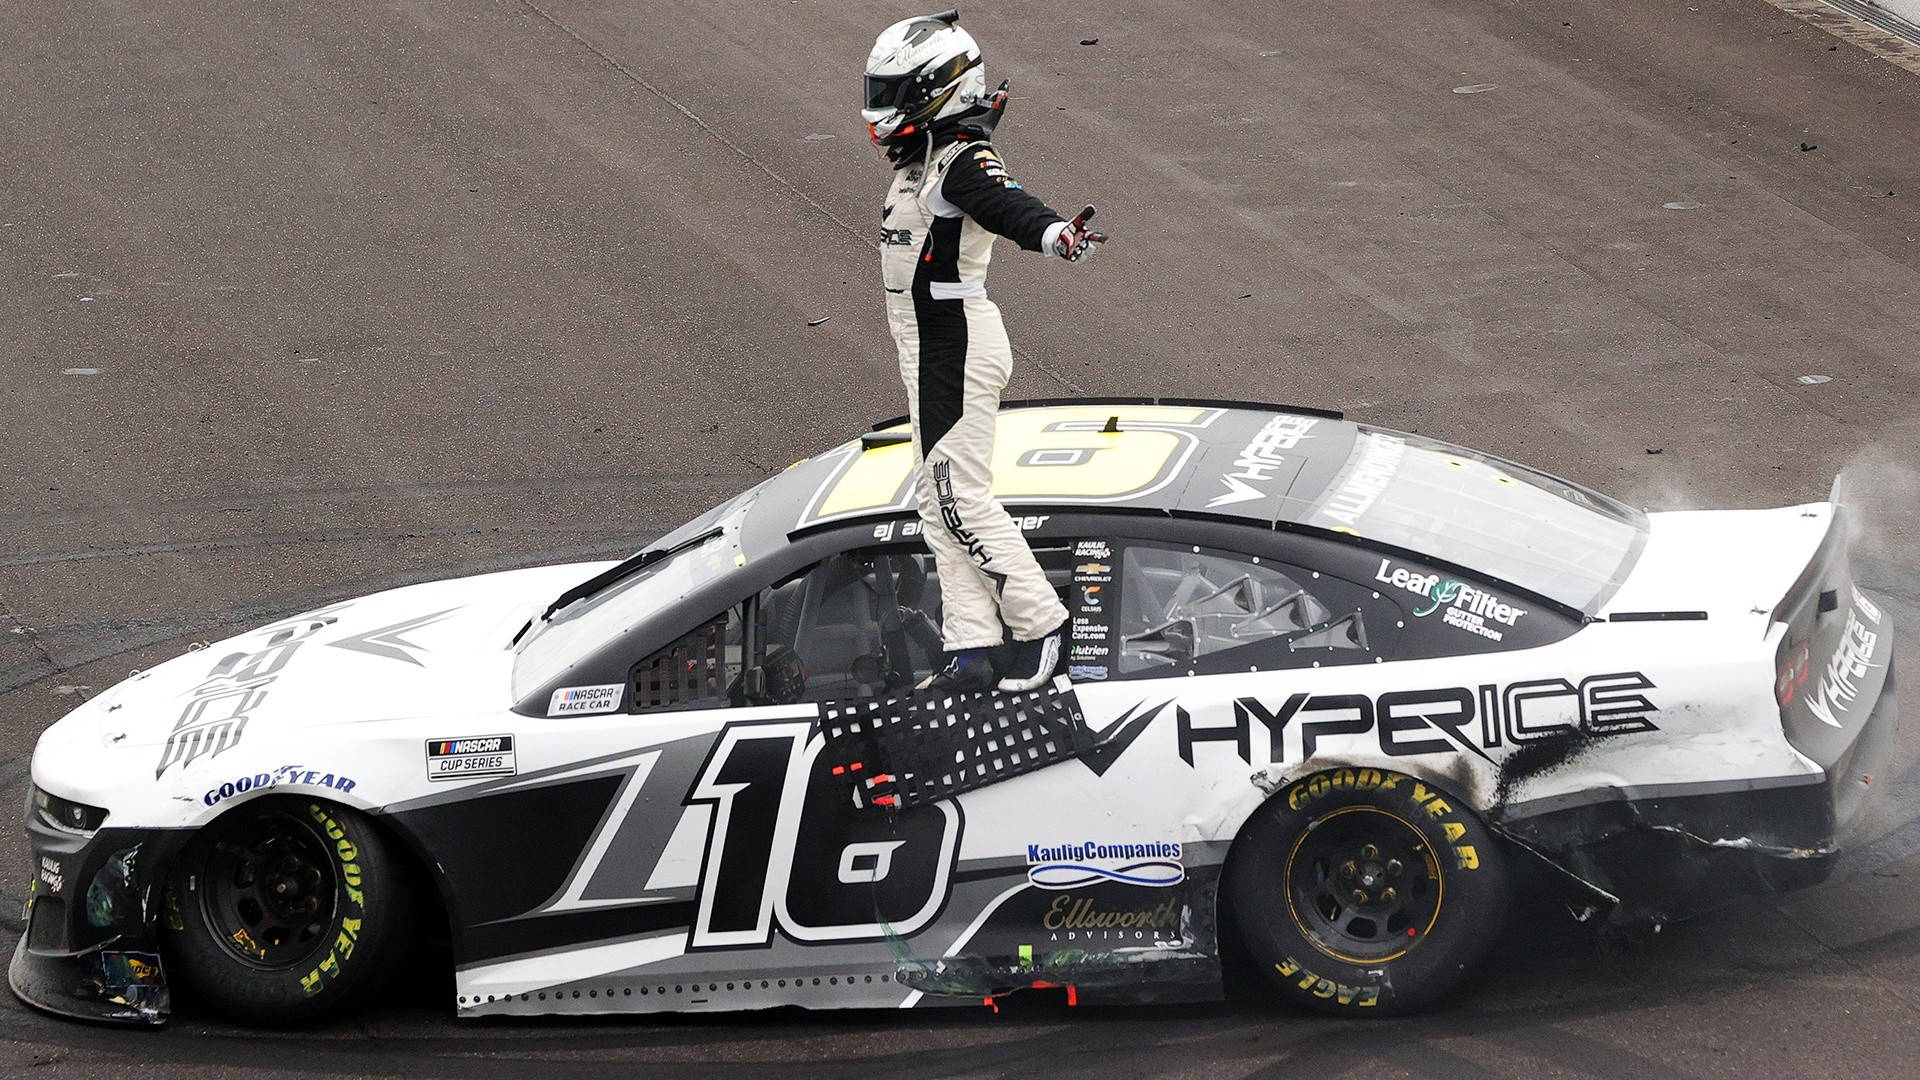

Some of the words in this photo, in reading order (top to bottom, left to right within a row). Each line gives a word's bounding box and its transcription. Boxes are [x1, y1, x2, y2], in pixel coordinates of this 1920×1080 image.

[1077, 541, 1106, 549] KAULIG
[1072, 616, 1089, 625] Less
[1446, 606, 1485, 626] GUTTER
[1071, 632, 1106, 640] Cars.com
[1072, 624, 1109, 634] Expensive
[1443, 615, 1503, 642] PROTECTION
[1071, 645, 1109, 656] Nutrien
[573, 687, 614, 700] NASCAR
[558, 700, 587, 711] RACE
[589, 699, 611, 709] CAR
[1176, 671, 1662, 769] HYPERICE
[454, 738, 502, 754] NASCAR
[440, 758, 463, 771] CUP
[464, 756, 504, 770] SERIES
[681, 718, 966, 953] 16
[1027, 841, 1181, 862] KauligCompanies
[1043, 894, 1179, 930] Ellsworth
[1050, 931, 1177, 941] ADVISORS
[1274, 955, 1381, 1007] EAGLE
